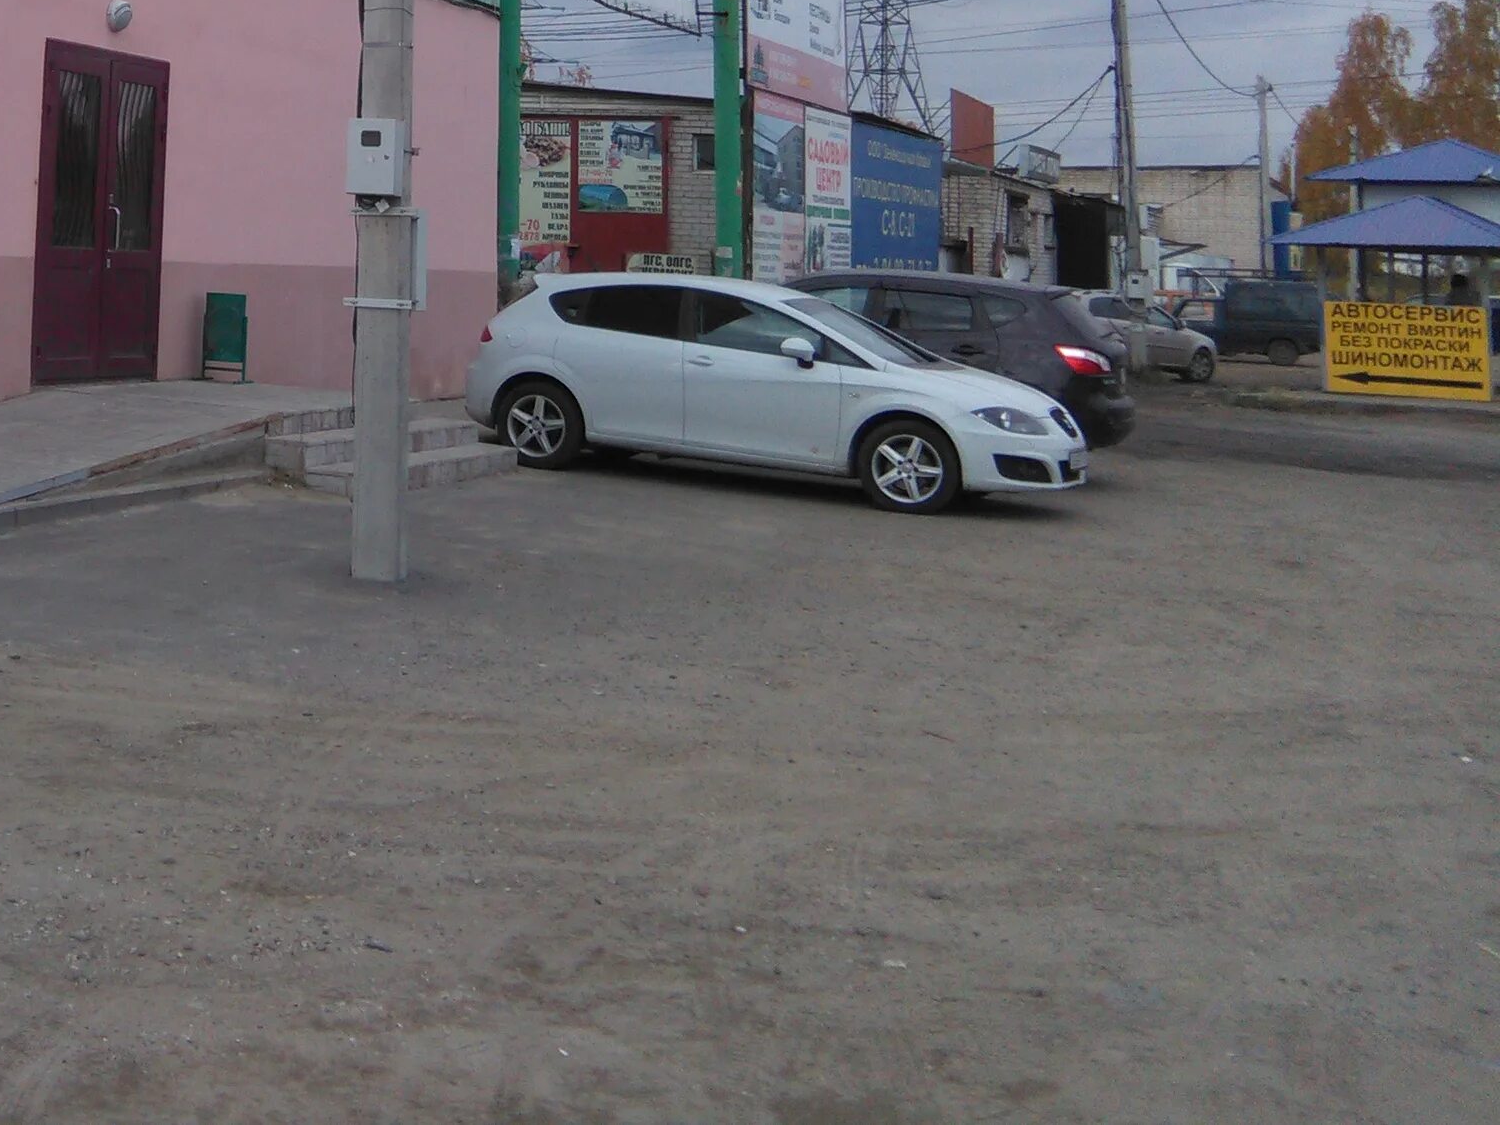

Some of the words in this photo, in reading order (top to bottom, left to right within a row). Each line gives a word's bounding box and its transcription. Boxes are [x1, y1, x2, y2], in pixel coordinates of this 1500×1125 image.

[533, 121, 571, 136] БАНИ!
[807, 137, 849, 166] САДОВЫЙ
[815, 167, 842, 194] ЦЕНТР
[1331, 303, 1480, 324] АВТОСЕРВИС
[1331, 321, 1403, 335] РЕМОНТ
[1407, 324, 1482, 339] ВМЯТИН
[1339, 335, 1372, 348] БЕЗ
[1377, 336, 1470, 353] ПОКРАСКИ
[1331, 350, 1483, 372] ШИНОМОНТАЖ
